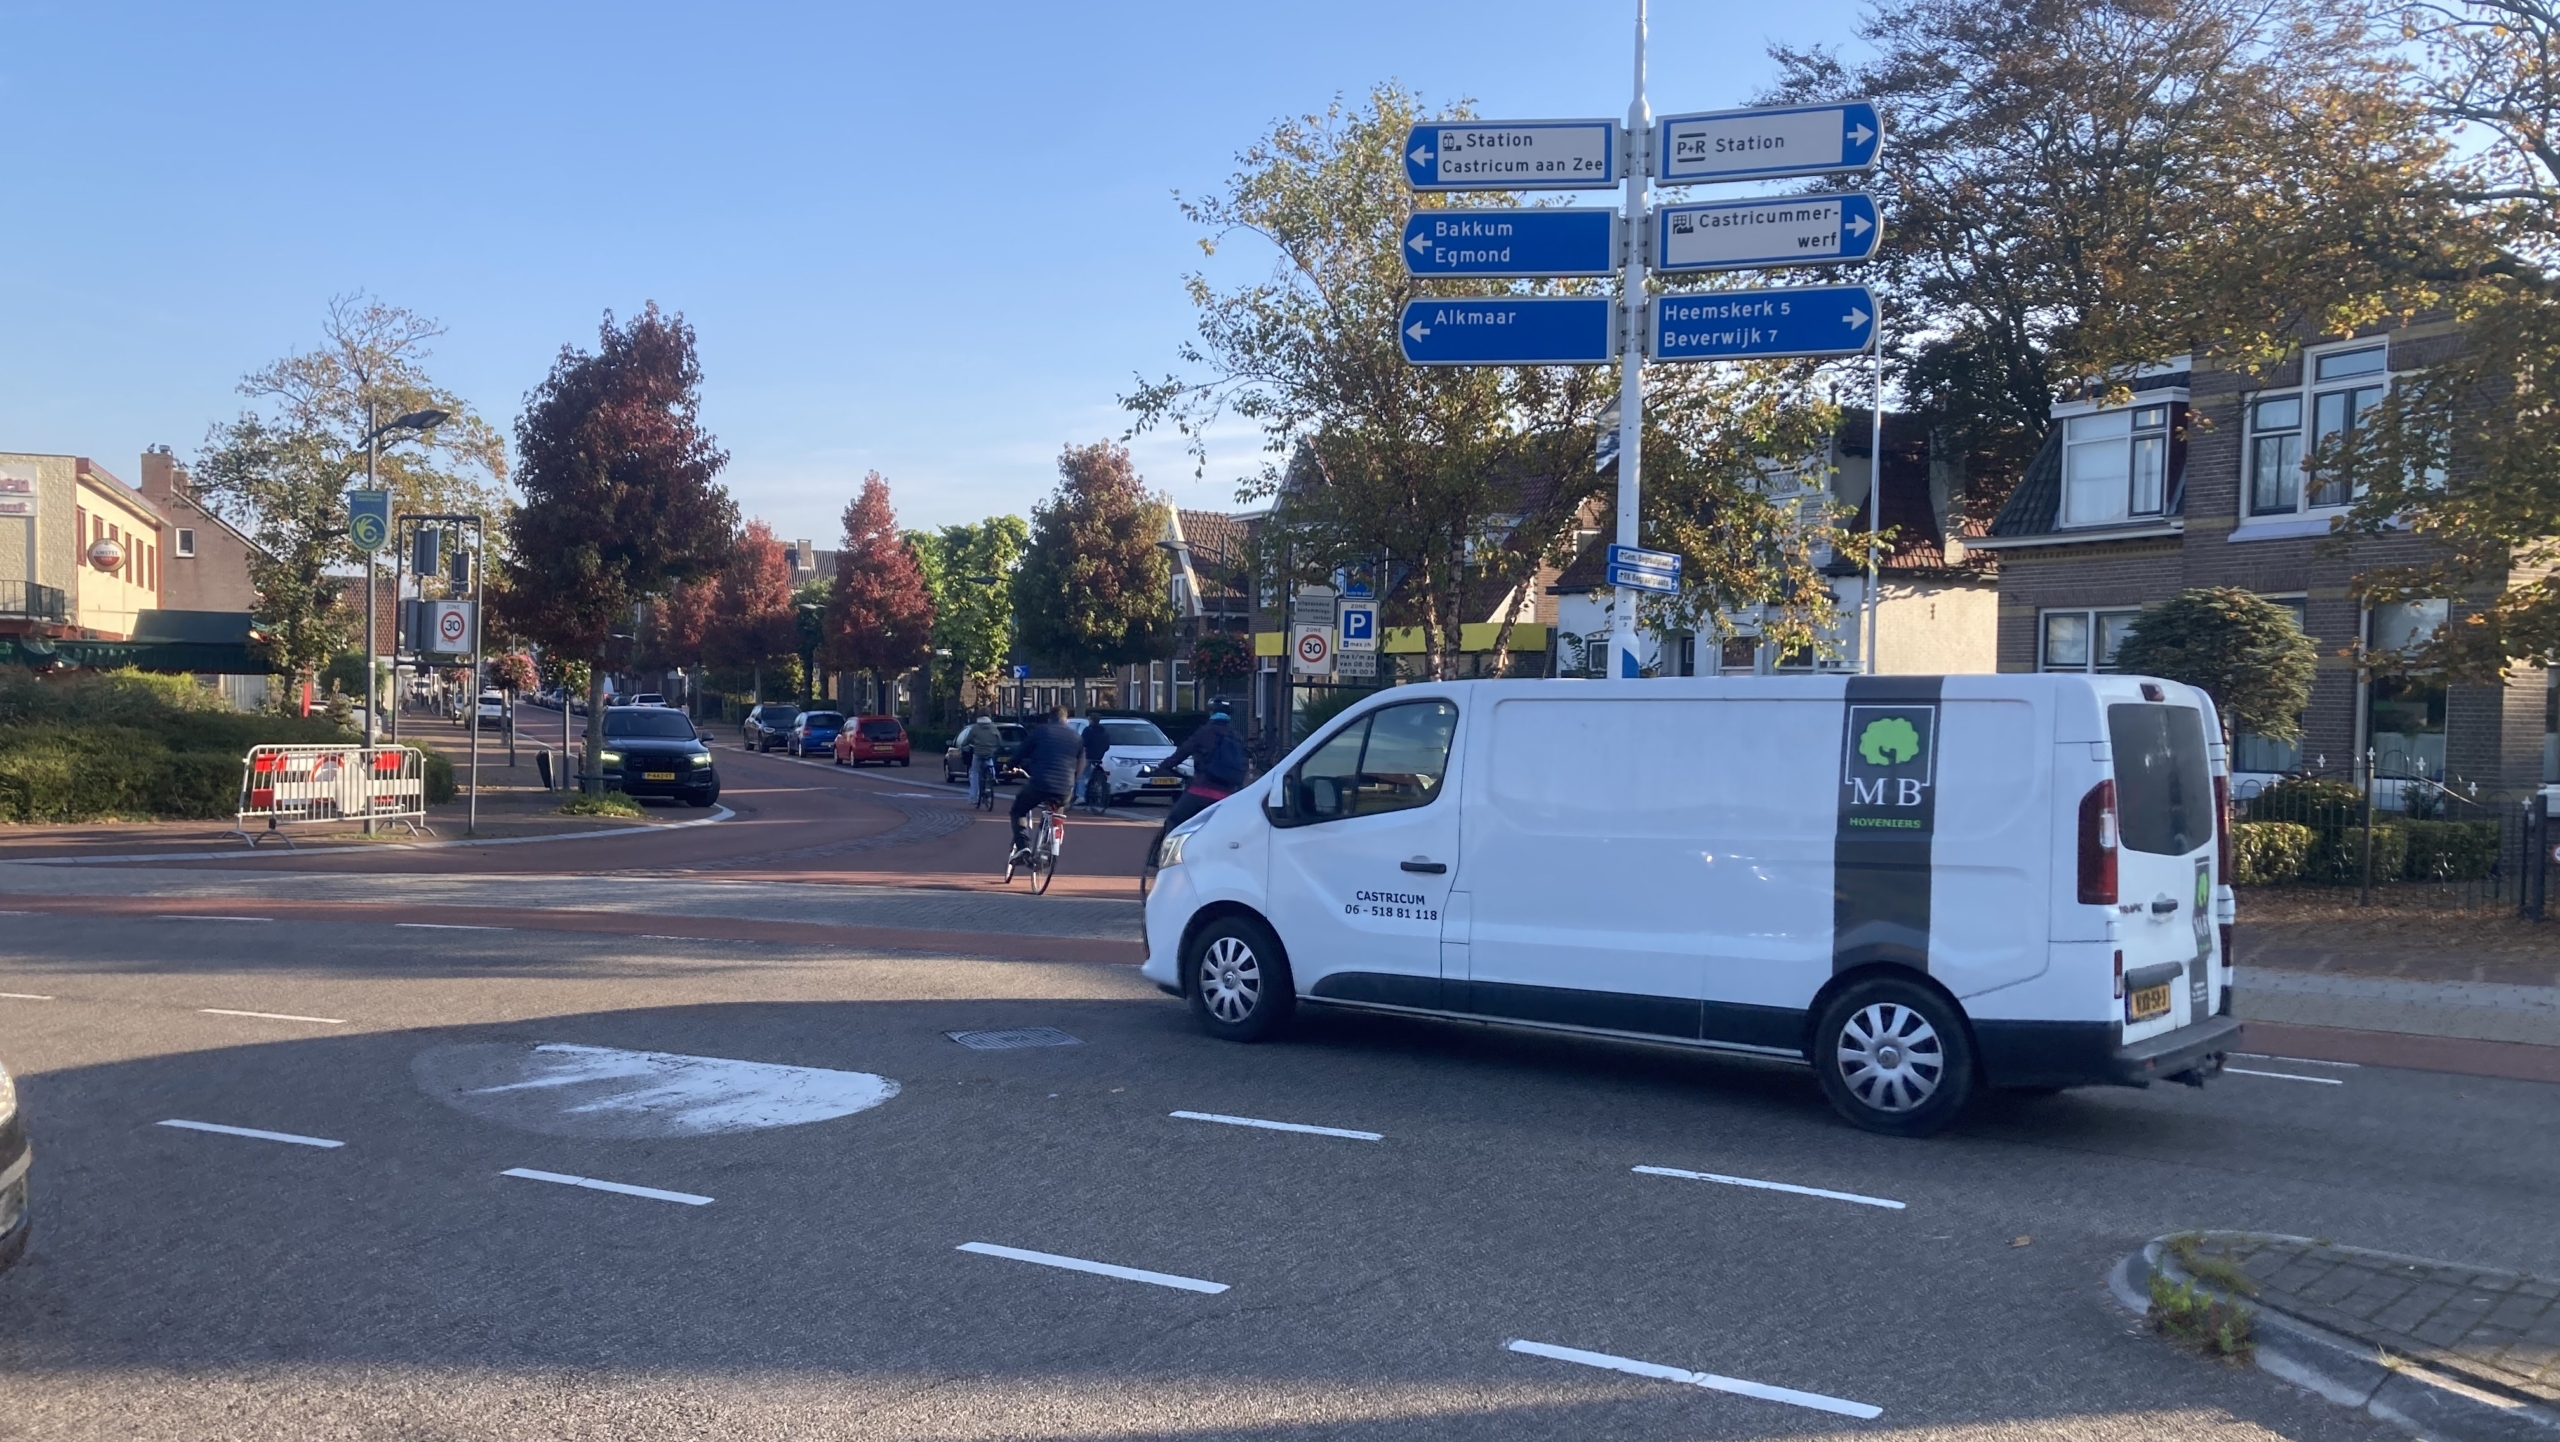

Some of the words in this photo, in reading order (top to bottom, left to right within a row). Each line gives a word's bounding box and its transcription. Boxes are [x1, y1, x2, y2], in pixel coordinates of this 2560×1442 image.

[1466, 133, 1533, 148] Station
[1677, 140, 1706, 155] P+R
[1715, 135, 1785, 153] Station
[1442, 159, 1529, 173] Castricum
[1535, 160, 1566, 172] aan
[1573, 157, 1604, 171] Zee
[1699, 206, 1839, 228] Castricummer-
[1435, 220, 1513, 237] Bakkum
[1797, 231, 1837, 248] werf
[1435, 247, 1511, 267] Egmond
[1434, 309, 1517, 325] Alkmaar
[1665, 300, 1774, 321] Heemskerk
[1780, 302, 1791, 316] 5
[1664, 327, 1762, 349] Beverwijk
[1768, 329, 1778, 343] 7
[445, 620, 461, 632] 30
[1350, 613, 1366, 636] P
[1303, 642, 1322, 654] 30
[1849, 817, 1921, 829] HOVENIERS
[1356, 890, 1425, 905] CASTRICUM
[1345, 904, 1360, 914] 06
[1371, 906, 1393, 917] 518
[1396, 907, 1411, 919] 81
[1415, 909, 1438, 920] 118
